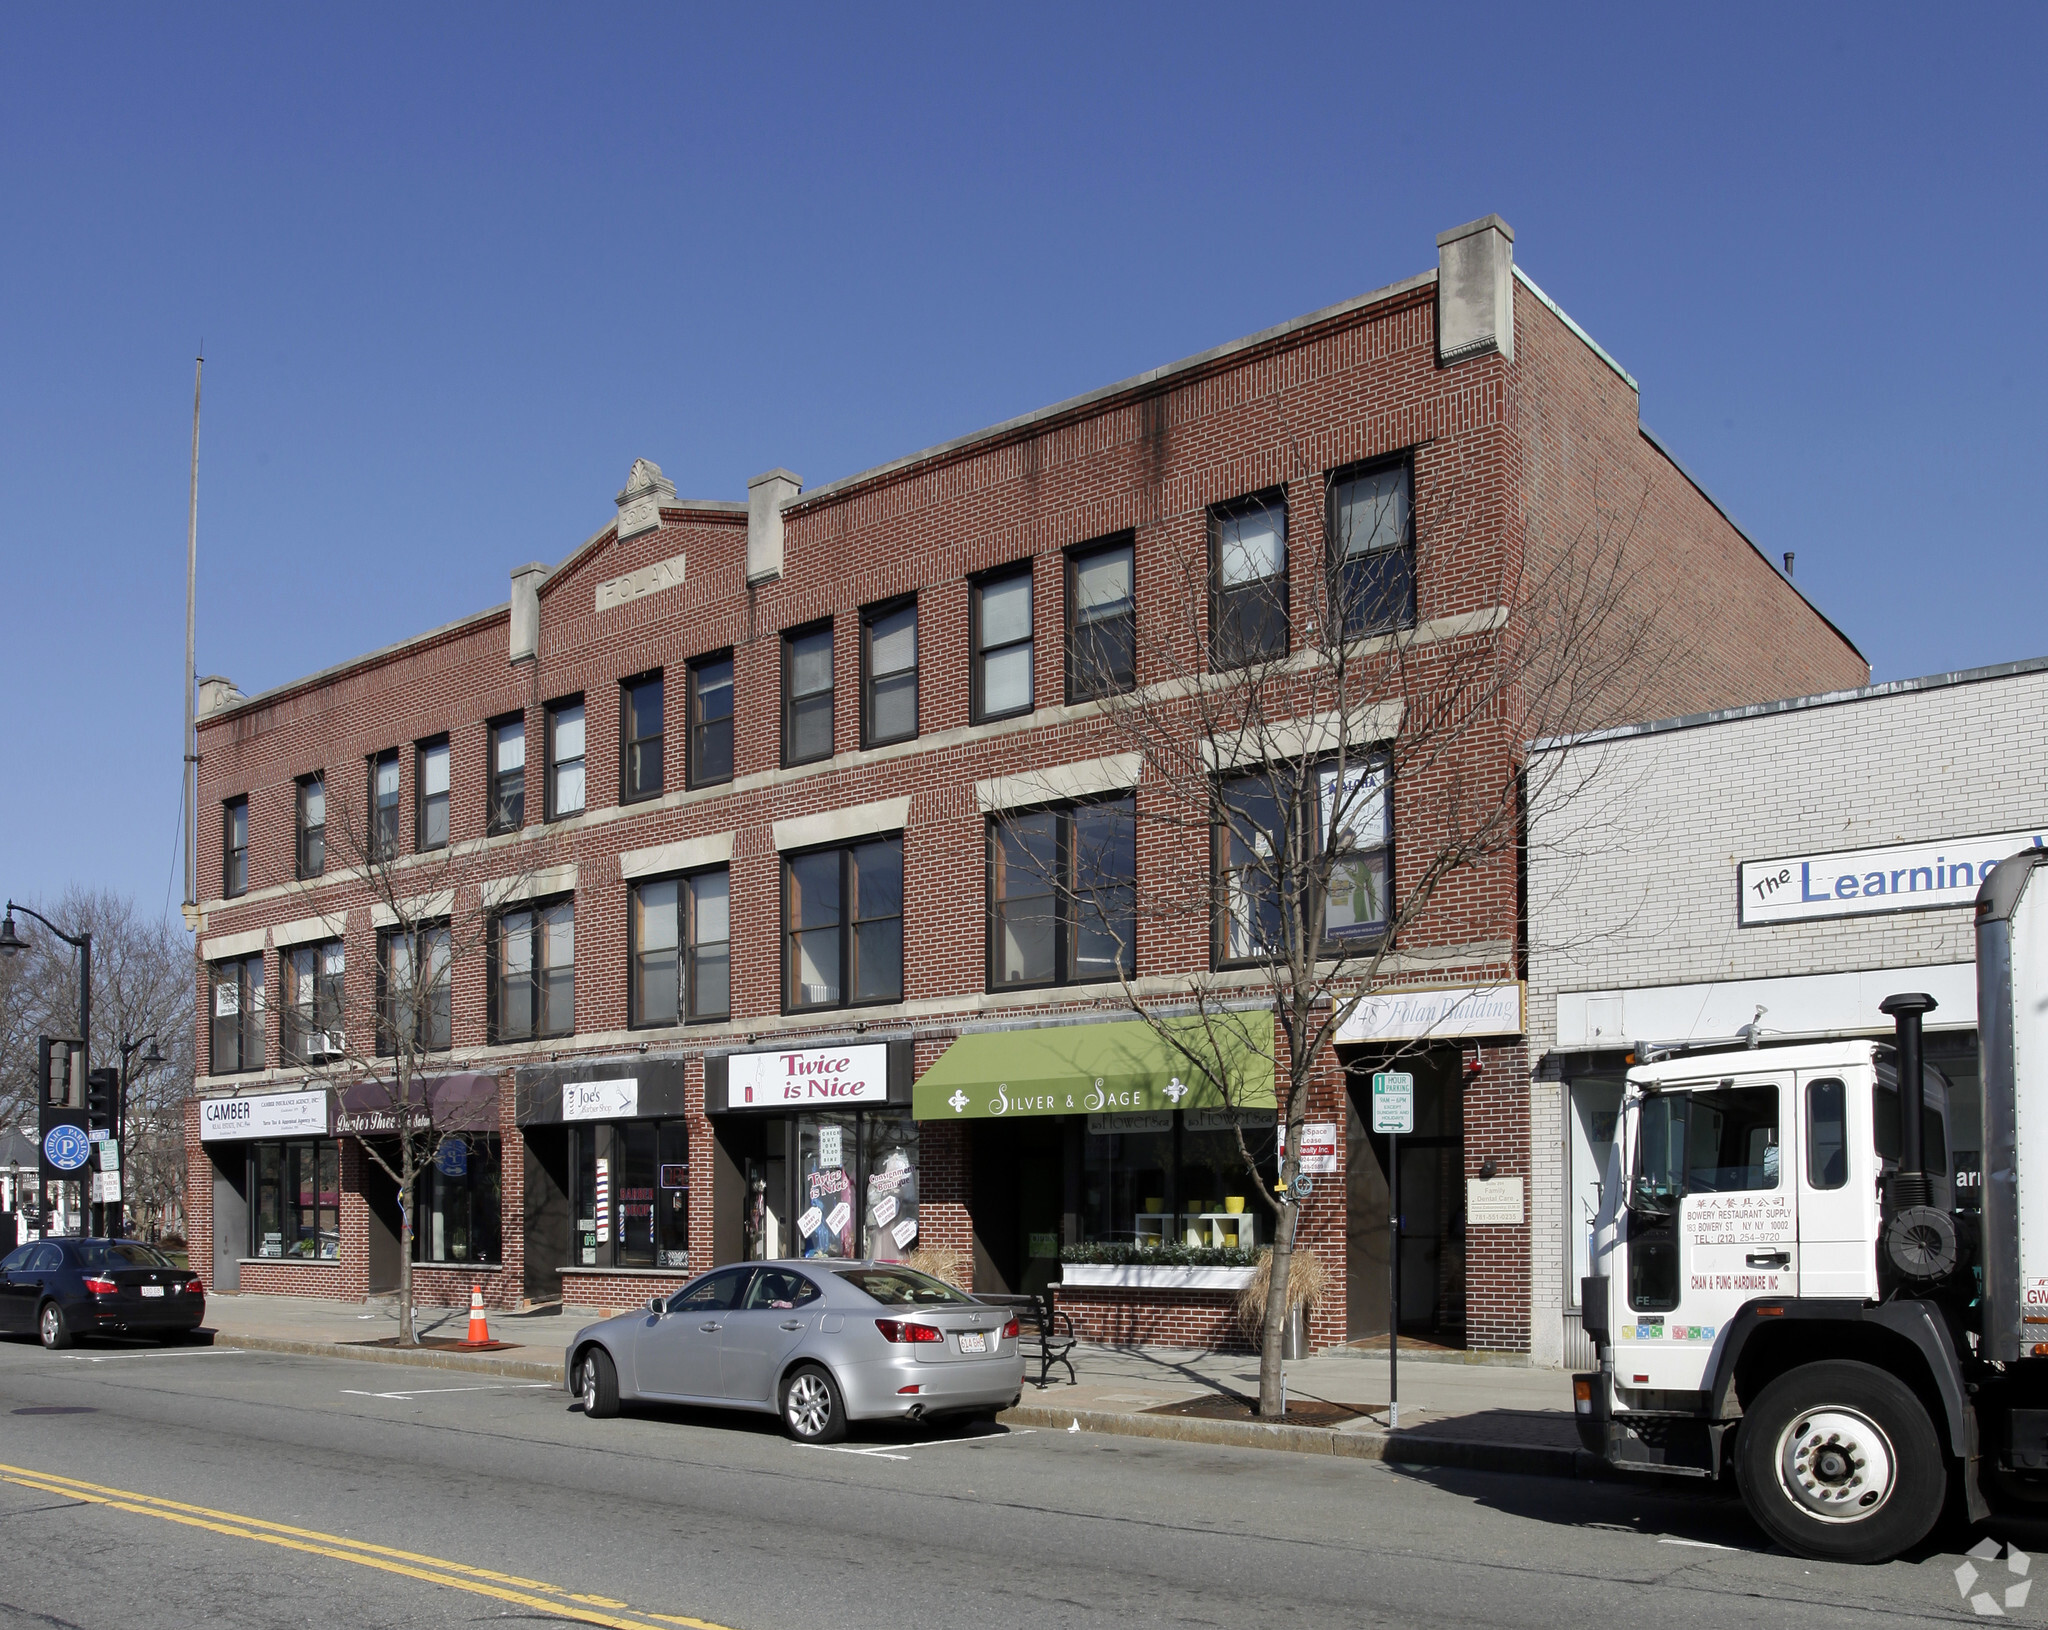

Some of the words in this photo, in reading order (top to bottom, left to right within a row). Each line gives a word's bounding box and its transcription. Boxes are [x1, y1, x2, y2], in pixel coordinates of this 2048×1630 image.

[1751, 867, 1791, 901] The
[1387, 1000, 1437, 1026] Folan
[1440, 994, 1513, 1023] Building
[779, 1053, 850, 1077] Twice
[783, 1081, 802, 1099] is
[807, 1077, 865, 1098] Nice
[1386, 1084, 1410, 1092] PARKING
[1387, 1076, 1407, 1084] HOUR
[578, 1086, 601, 1108] Joe's
[988, 1083, 1054, 1115] SILVER
[1065, 1094, 1074, 1108] &
[1083, 1077, 1141, 1111] SAGE
[206, 1101, 250, 1121] CAMBER
[581, 1104, 599, 1113] Barber
[600, 1104, 613, 1114] Shop
[48, 1129, 62, 1160] PUBLIC
[61, 1140, 74, 1155] P
[67, 1128, 87, 1161] PARKING
[663, 1167, 689, 1186] OPE
[808, 1169, 842, 1188] Twice
[869, 1164, 916, 1185] Consignment
[810, 1187, 820, 1200] is
[821, 1178, 849, 1197] Nice
[877, 1176, 910, 1192] Boutique
[1484, 1187, 1506, 1195] Family
[619, 1187, 654, 1200] BARBER
[624, 1204, 651, 1217] SHOP
[1687, 1210, 1716, 1221] BOWERY
[1718, 1209, 1763, 1220] RESTAURANT
[1765, 1208, 1792, 1219] SUPPLY
[1686, 1223, 1696, 1232] 183
[1698, 1222, 1723, 1232] BOWERY
[1770, 1220, 1789, 1230] 10002
[1717, 1233, 1736, 1244] (212)
[1739, 1232, 1780, 1242] 254-9720
[1691, 1275, 1707, 1291] CHAN
[1709, 1276, 1714, 1290] &
[1715, 1275, 1732, 1290] FUNG
[1733, 1275, 1766, 1290] HARDWARE
[1635, 1296, 1650, 1306] FE
